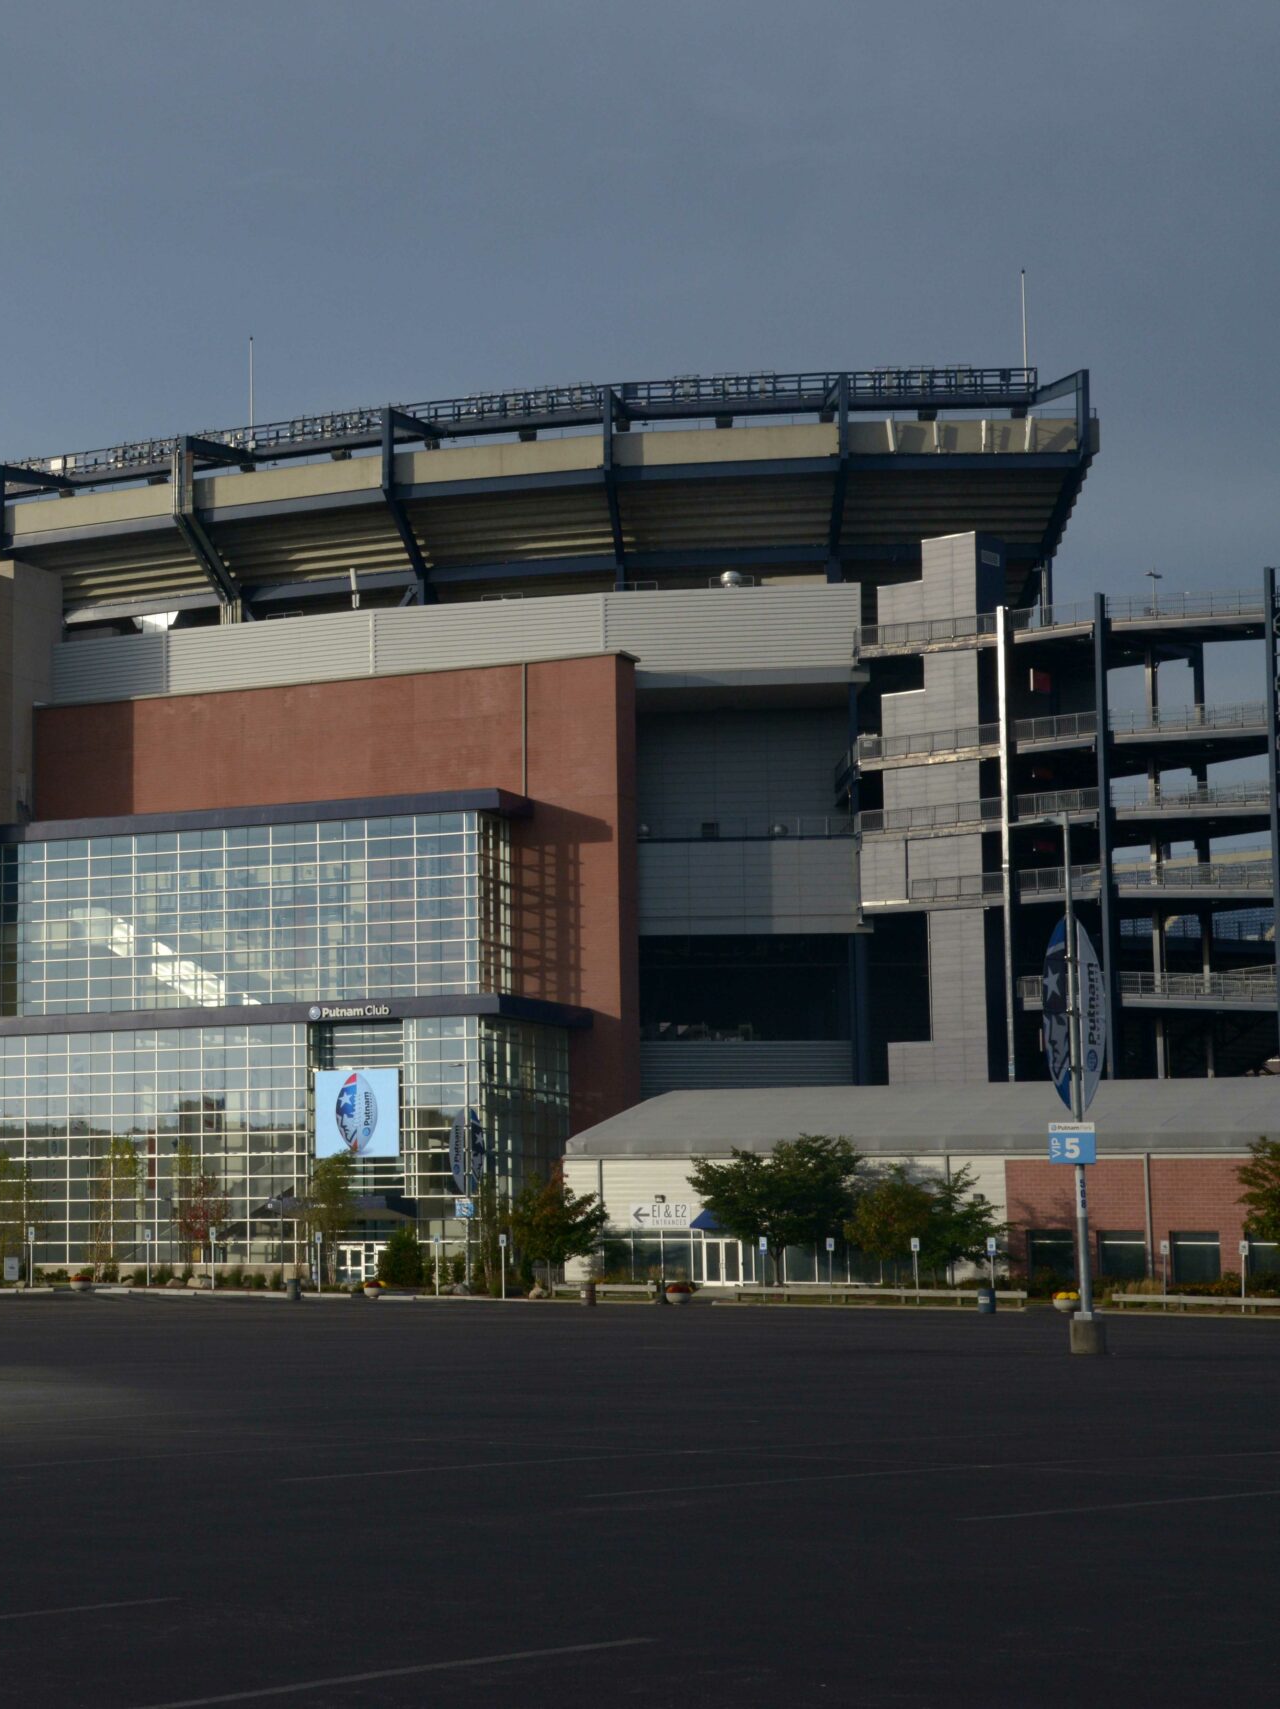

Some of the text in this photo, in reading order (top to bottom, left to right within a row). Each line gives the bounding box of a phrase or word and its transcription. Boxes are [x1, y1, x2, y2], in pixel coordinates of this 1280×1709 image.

[322, 1004, 390, 1018] Putnam Club
[1087, 963, 1096, 1046] Putnam
[1051, 1137, 1061, 1158] VIP
[1064, 1137, 1081, 1159] 5
[663, 1204, 673, 1218] &
[675, 1204, 687, 1218] E2
